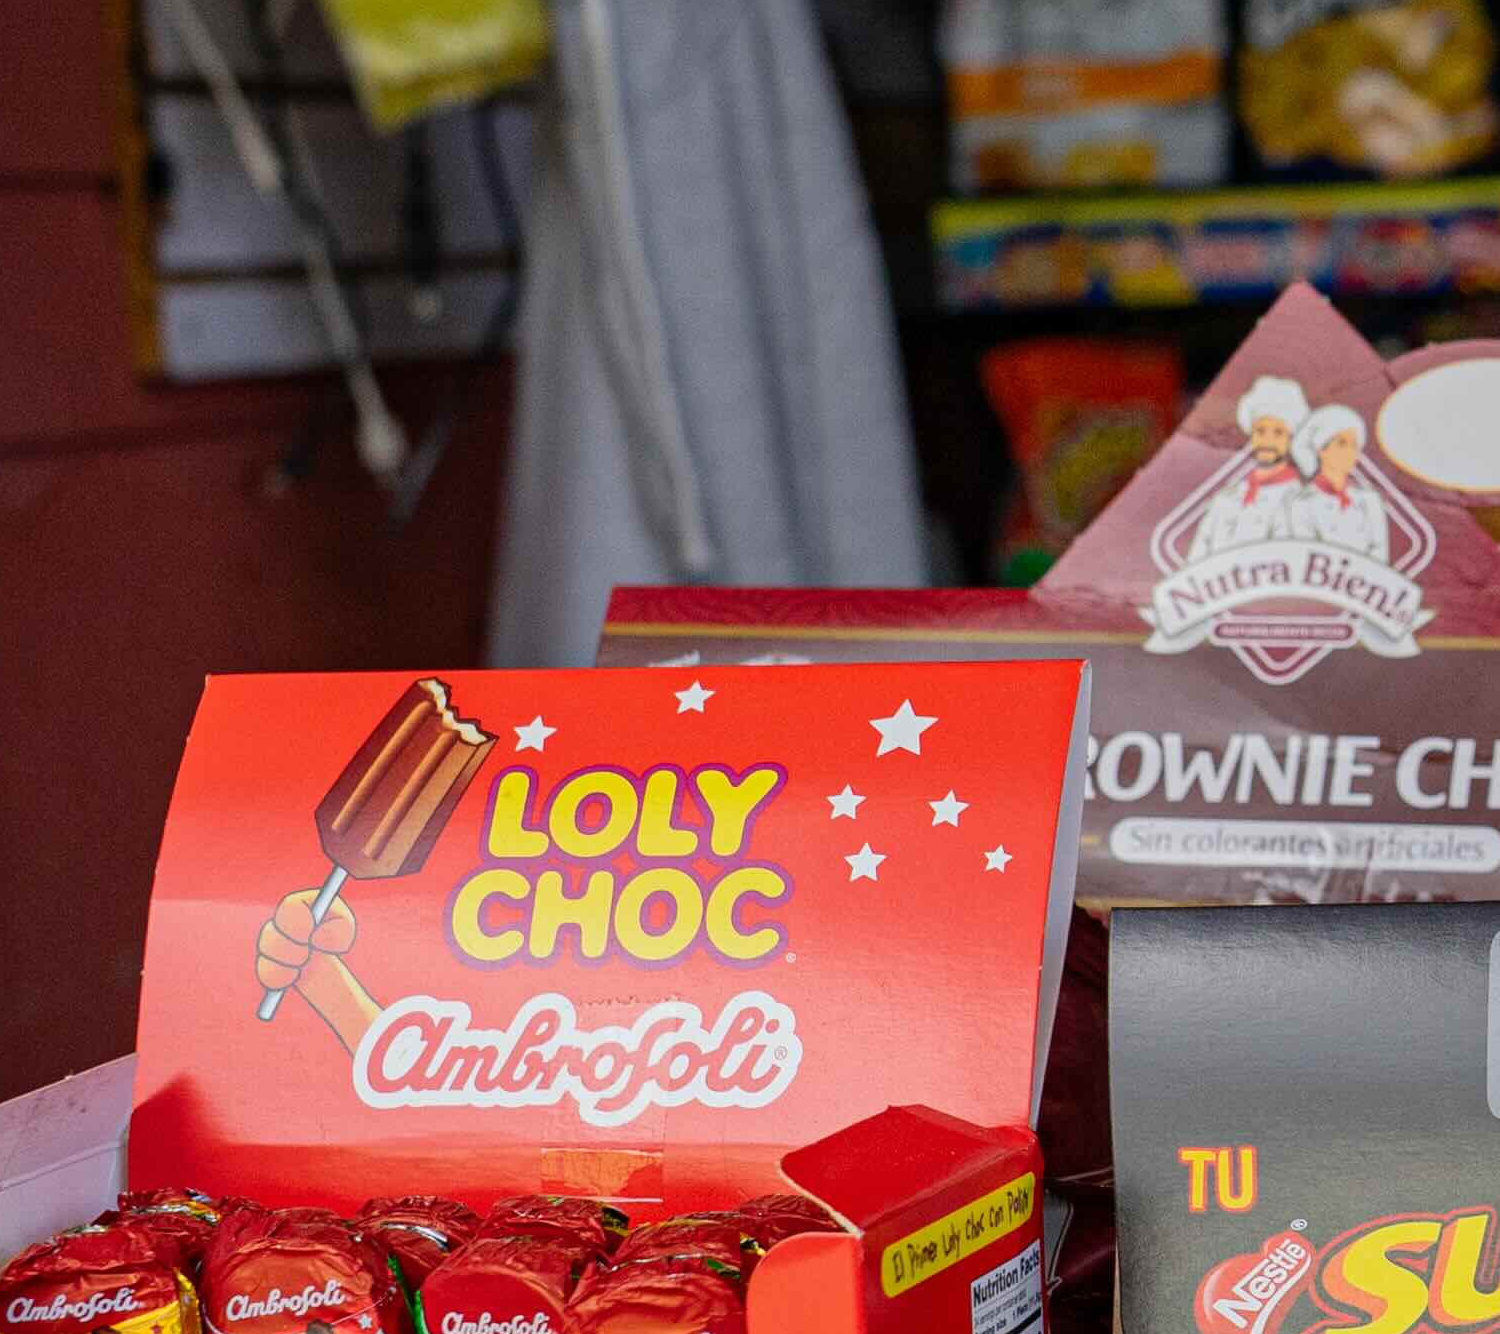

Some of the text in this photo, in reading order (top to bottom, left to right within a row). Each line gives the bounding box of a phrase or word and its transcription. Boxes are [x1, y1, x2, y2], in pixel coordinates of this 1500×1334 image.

[1166, 547, 1412, 624] Nutra Bien!
[485, 765, 786, 861] LOLY
[1128, 825, 1173, 852] Sin
[1178, 825, 1327, 858] colorantes
[448, 867, 787, 964] CHOC
[1180, 1146, 1258, 1211] TU
[973, 1250, 1041, 1308] Nutrition Facts
[1213, 1238, 1309, 1329] Nestlé
